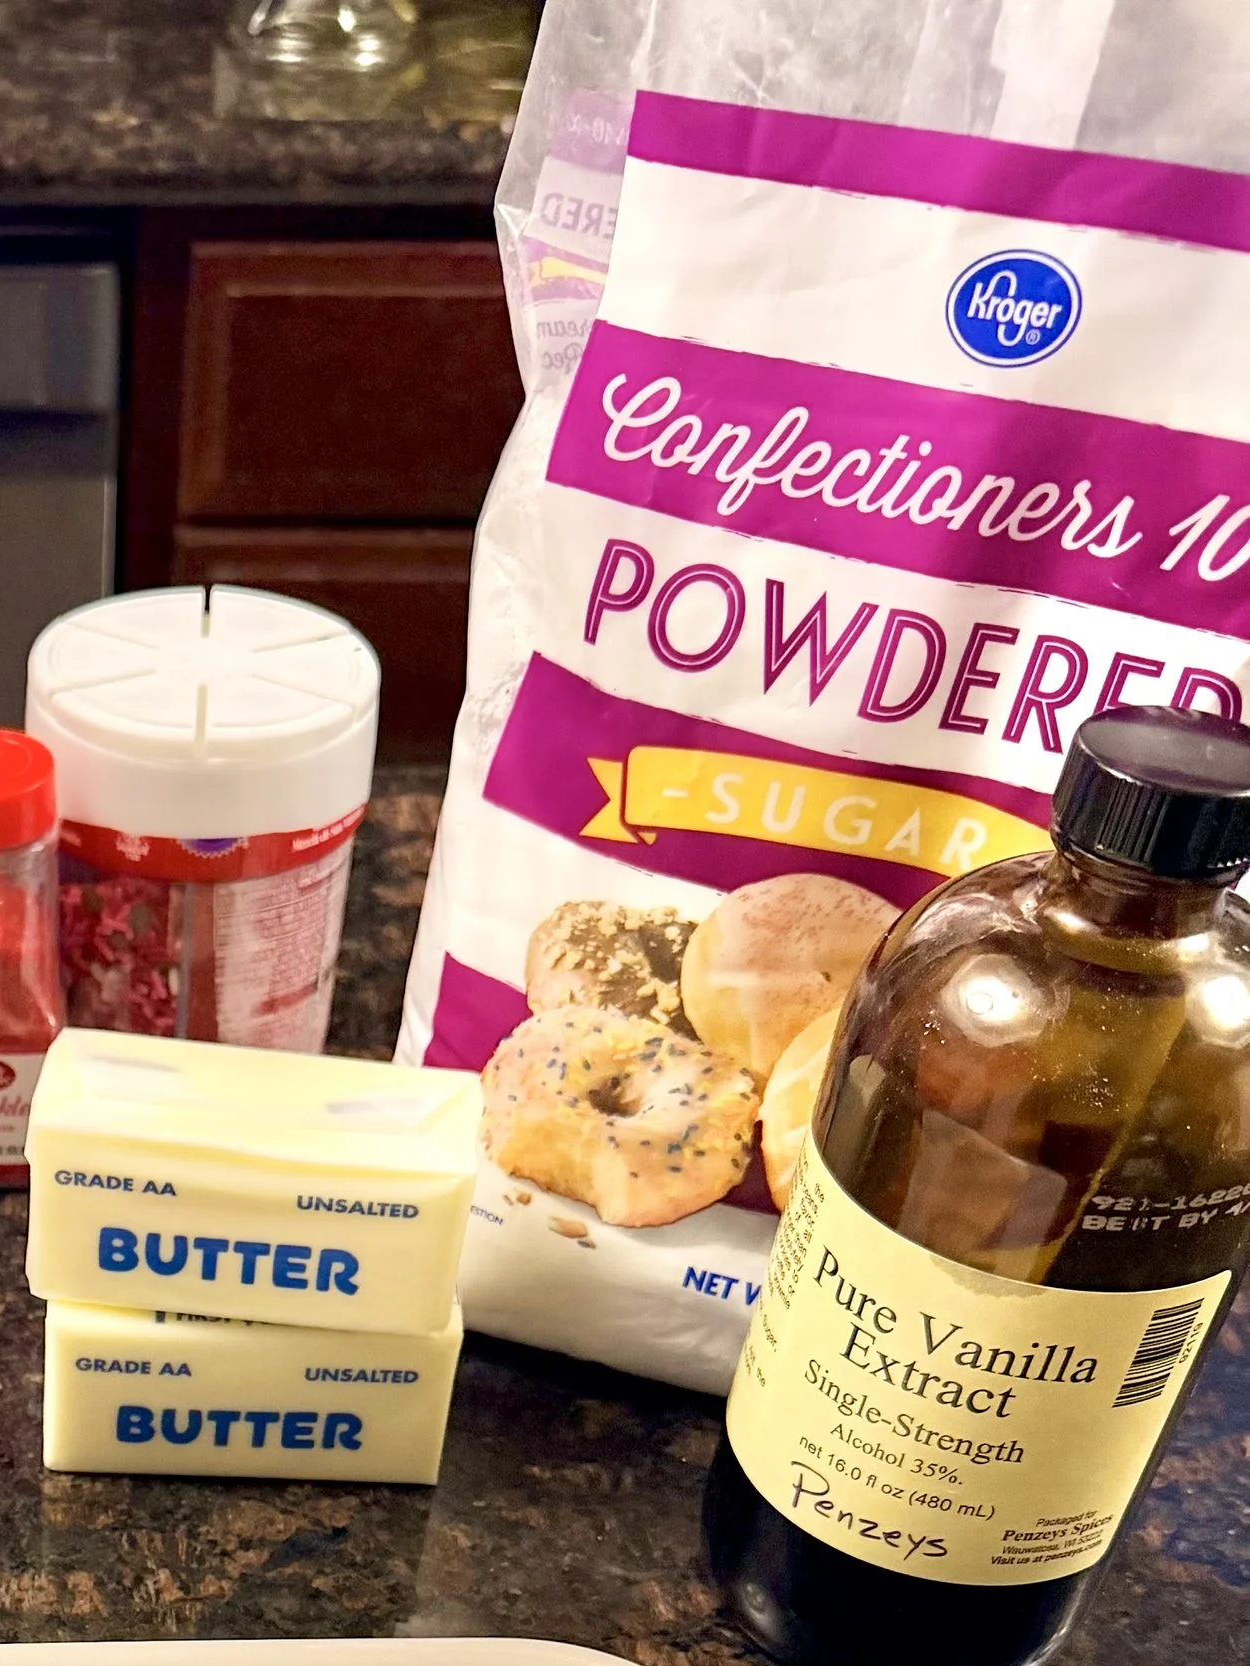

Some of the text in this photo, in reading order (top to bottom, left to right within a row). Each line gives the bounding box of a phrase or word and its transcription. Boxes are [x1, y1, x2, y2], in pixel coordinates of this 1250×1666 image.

[967, 269, 1064, 347] Kroger
[602, 373, 1143, 559] Confectioners
[54, 1169, 178, 1198] GRADE AA
[296, 1195, 420, 1219] UNSALTED
[1178, 1208, 1218, 1229] BY
[97, 1226, 360, 1296] BUTTER
[683, 1266, 740, 1301] NET
[812, 1244, 1098, 1384] Pure Vanilla
[75, 1356, 192, 1377] GRADE AA
[304, 1367, 419, 1385] UNSALTED
[839, 1321, 1016, 1418] Extract
[115, 1404, 364, 1451] BUTTER
[804, 1359, 1025, 1464] Single-Strength
[830, 1423, 963, 1486] Alcohol 35%.
[799, 1436, 996, 1521] net 16.0 fl oz (480 mL)
[790, 1460, 949, 1561] Penzeys
[1002, 1514, 1114, 1542] Penzeys Spices
[1036, 1512, 1085, 1528] Packaged
[991, 1556, 1014, 1565] Visit
[1016, 1556, 1030, 1565] us
[1032, 1554, 1043, 1563] at
